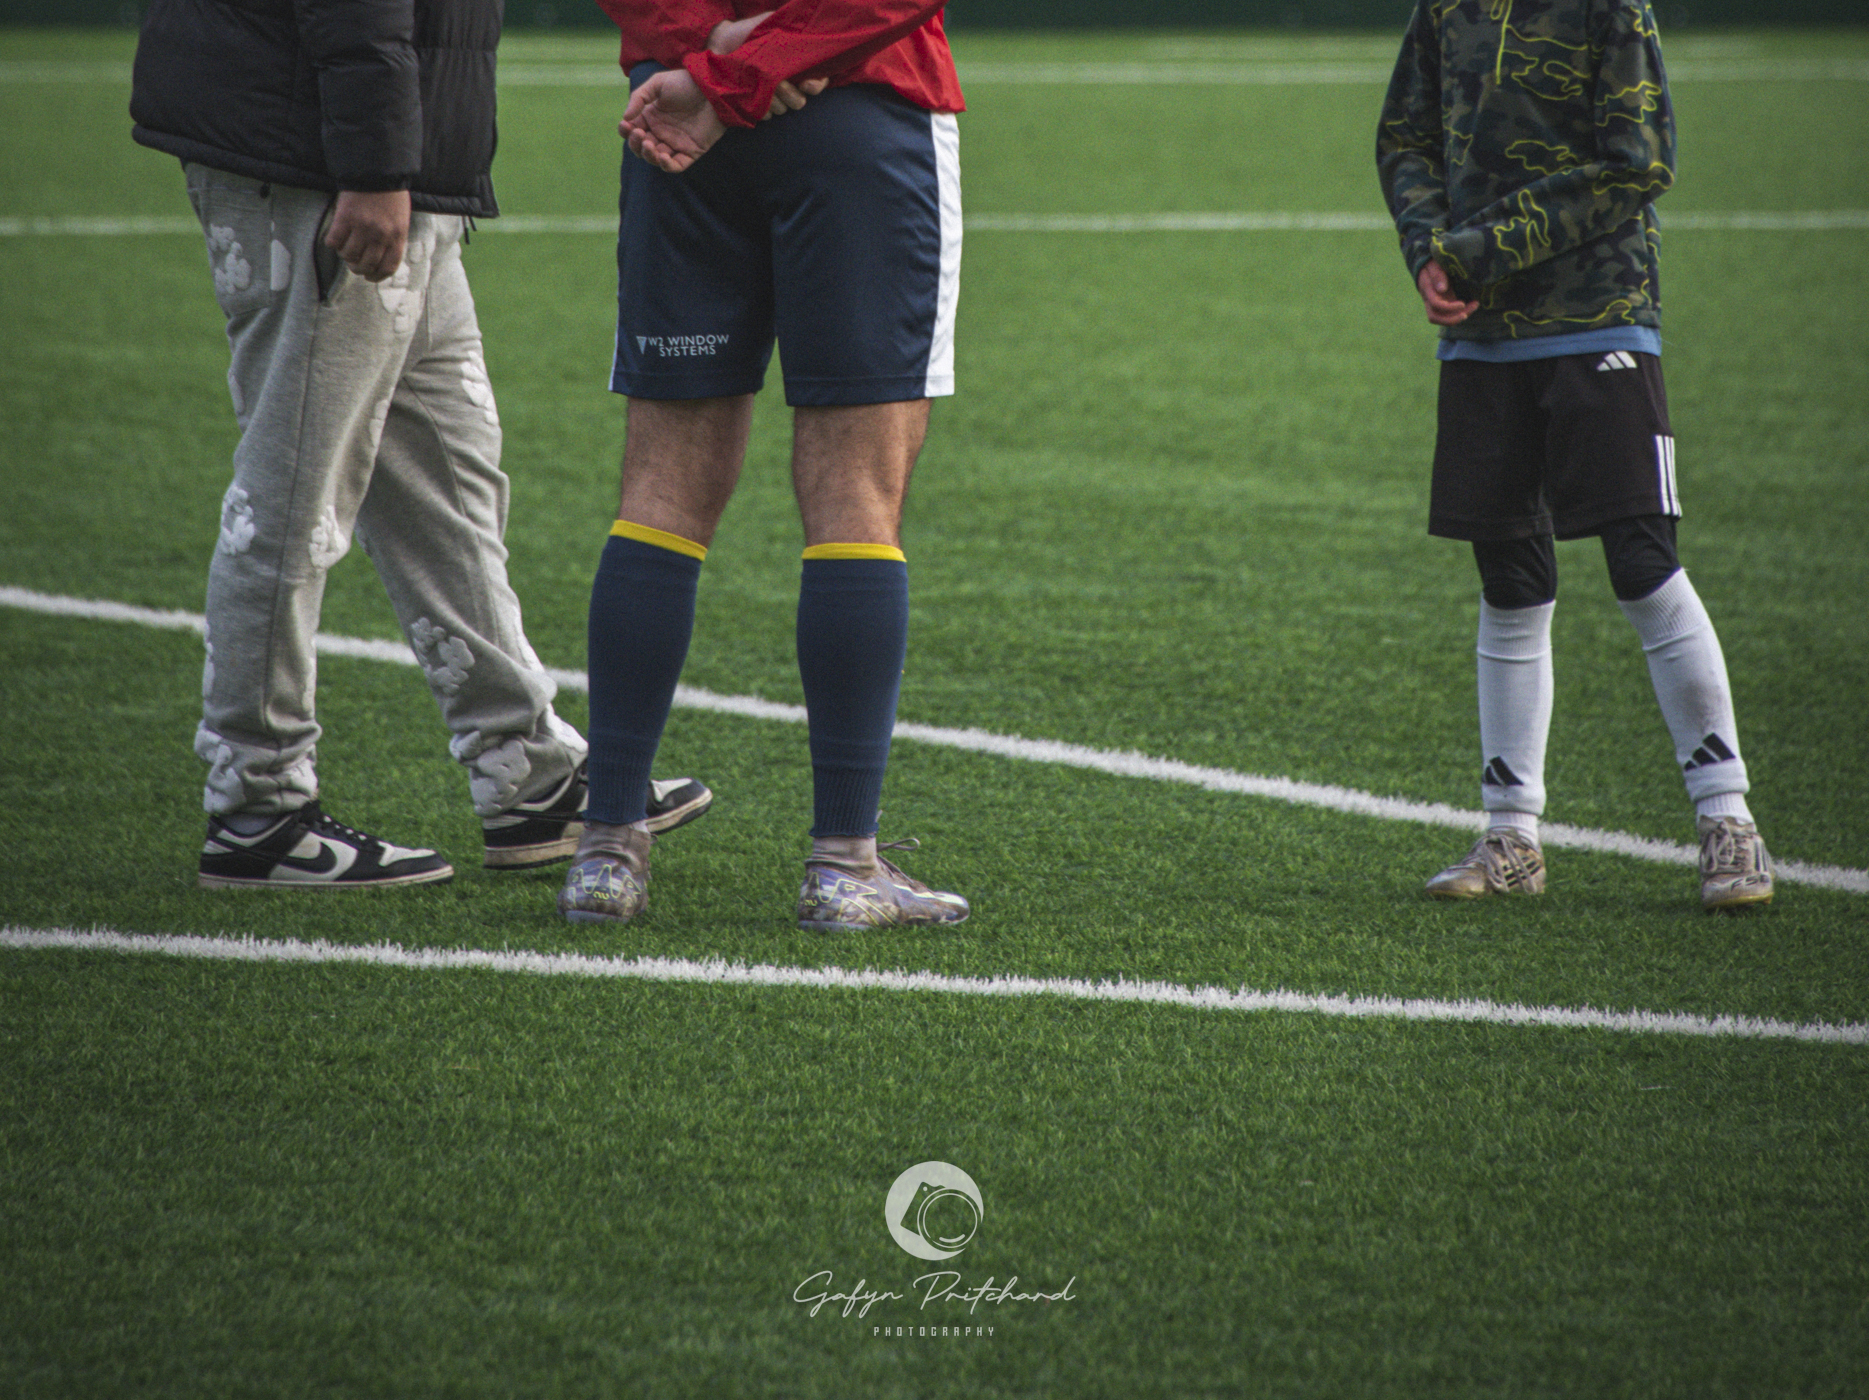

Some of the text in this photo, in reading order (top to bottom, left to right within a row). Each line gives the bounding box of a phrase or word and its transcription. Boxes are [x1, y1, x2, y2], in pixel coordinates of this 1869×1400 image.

[648, 334, 730, 347] W2 WINDOW
[659, 345, 717, 357] SYSTEMS
